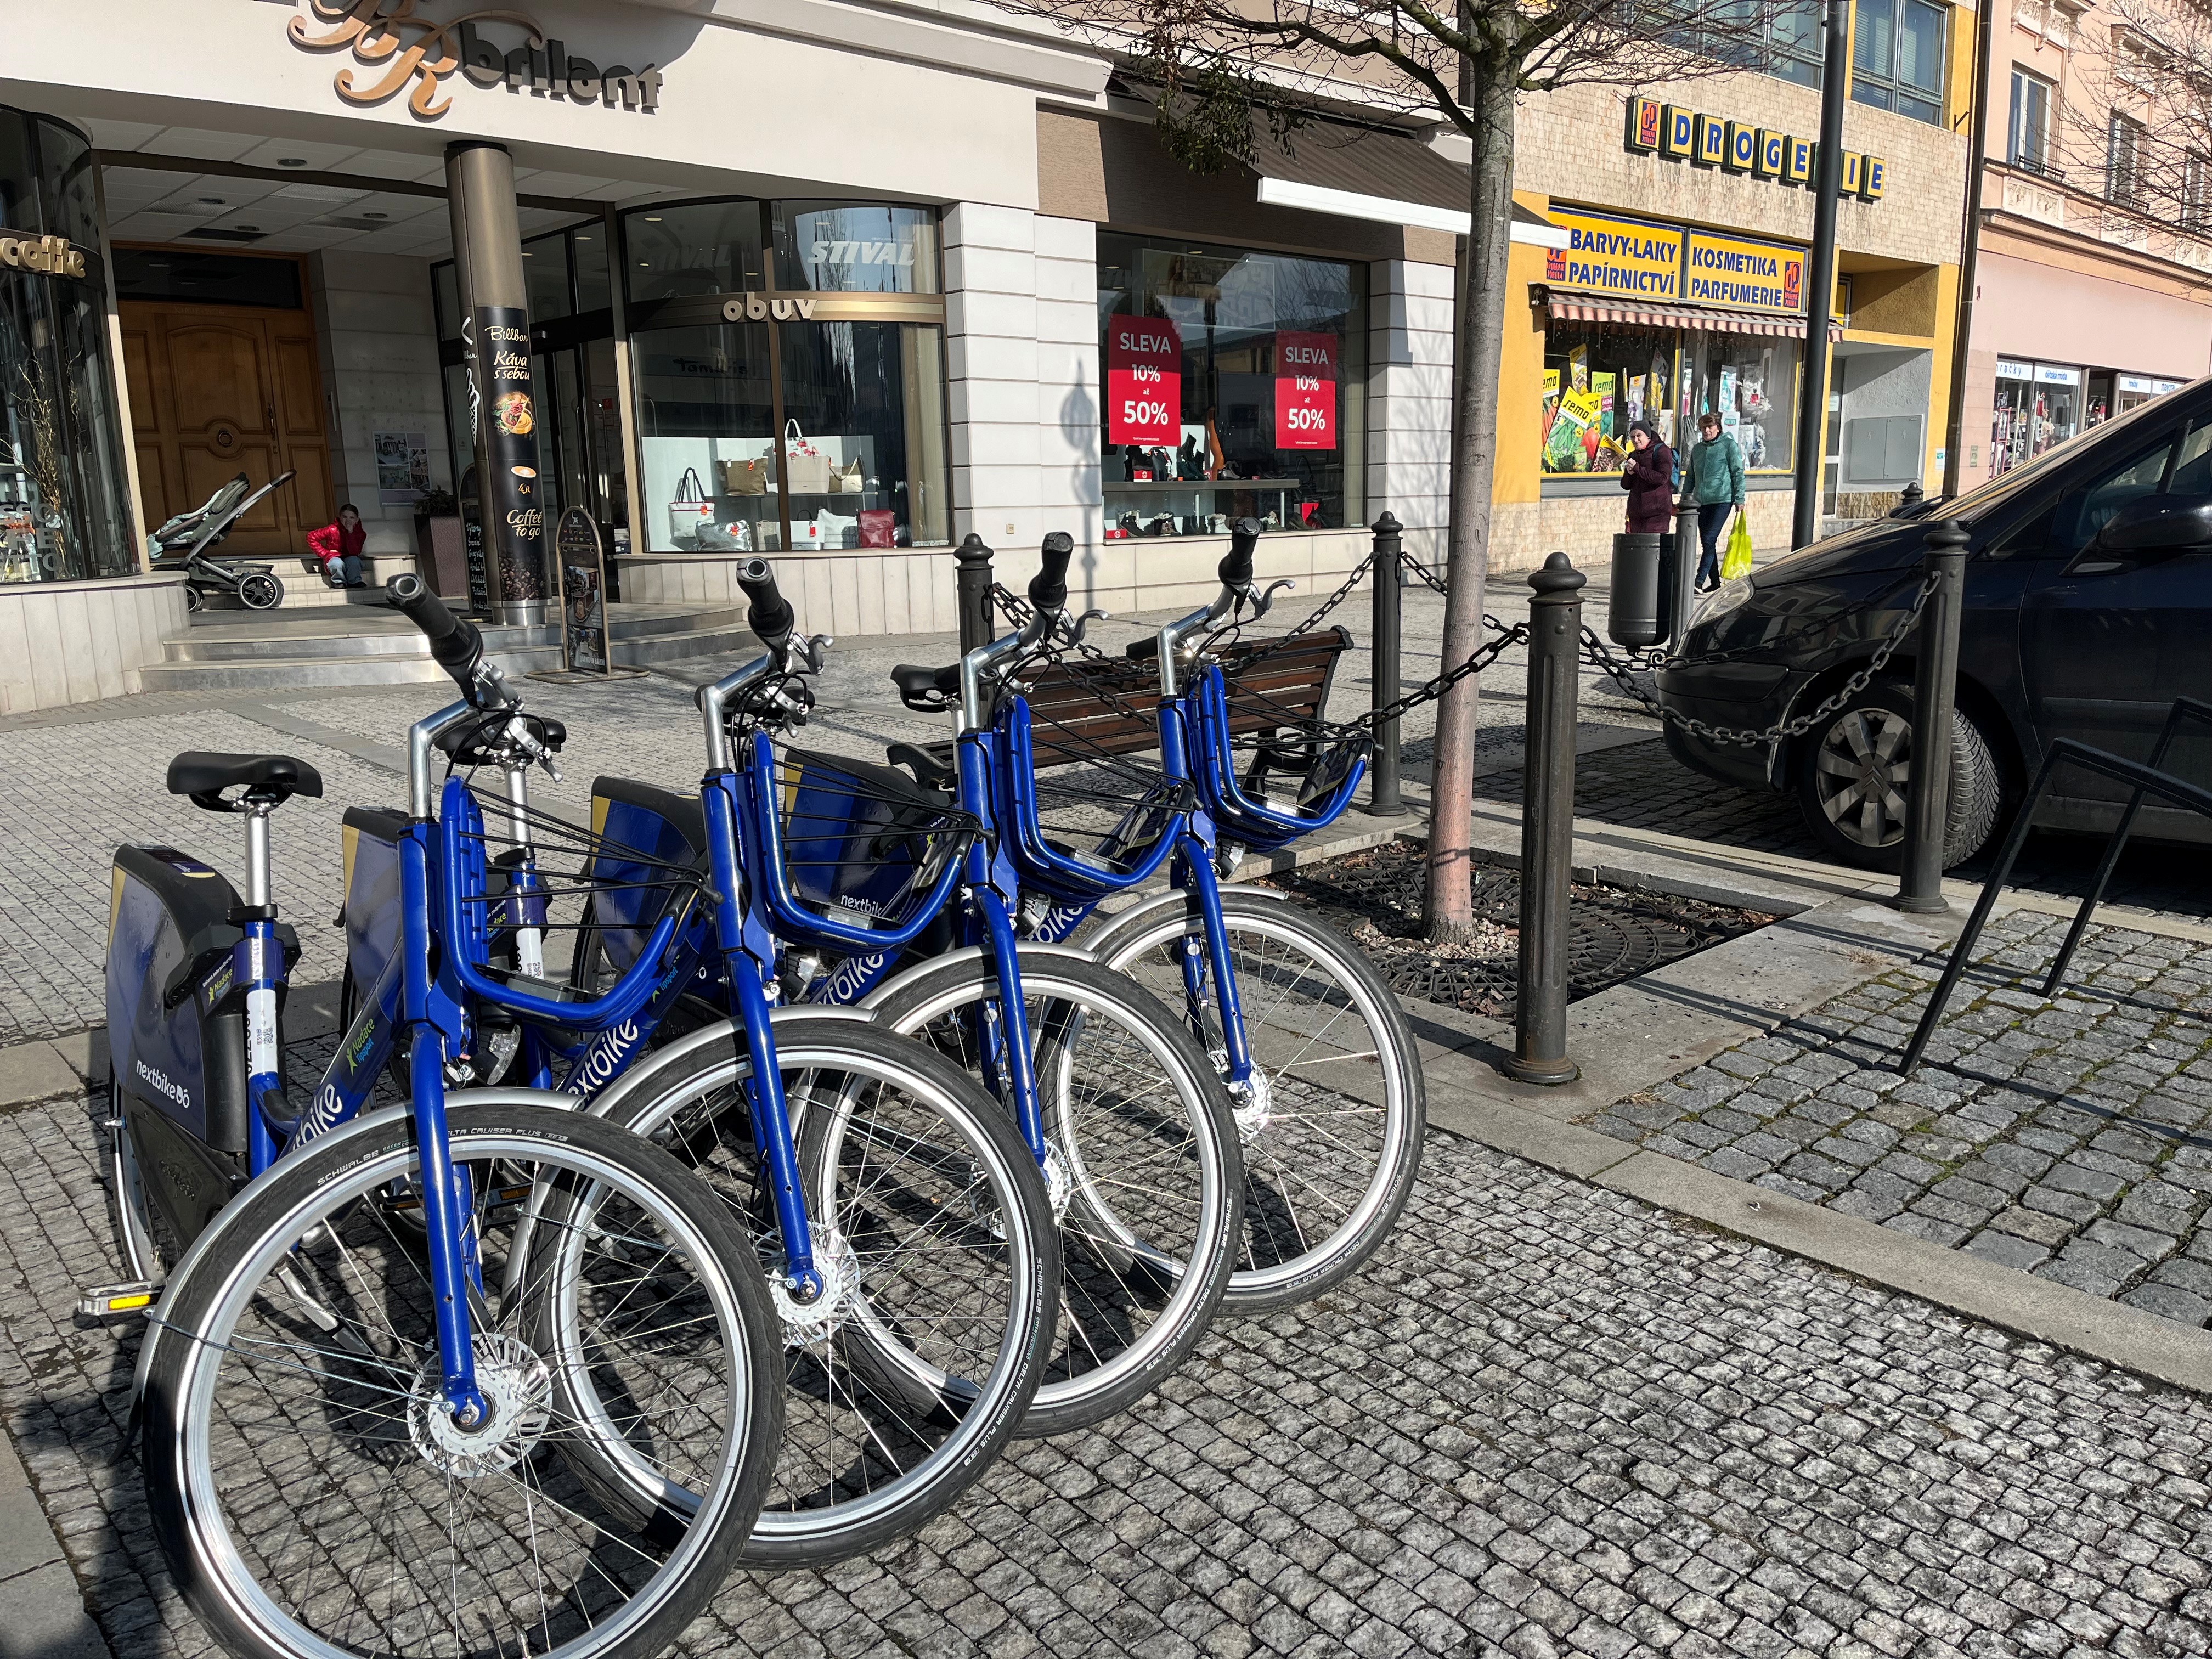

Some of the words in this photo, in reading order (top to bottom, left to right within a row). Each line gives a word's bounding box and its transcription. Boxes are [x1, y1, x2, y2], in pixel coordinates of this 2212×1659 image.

[1674, 114, 1883, 190] DROGEIE
[0, 235, 86, 278] caffe
[807, 241, 915, 266] STIVAL
[1570, 228, 1677, 263] BARVY-LAKY
[1692, 246, 1778, 278] KOSMETIKA
[1568, 262, 1675, 294] PAPÍRNICTVÍ
[1691, 278, 1782, 307] PARFUMERIE
[722, 291, 817, 322] obuv
[484, 326, 528, 342] Billbar
[1120, 332, 1171, 354] SLEVA
[494, 350, 527, 366] Káva
[1286, 346, 1329, 365] SLEVA
[494, 370, 500, 379] s
[501, 366, 530, 380] sebou
[1132, 364, 1160, 382] 10%
[1295, 375, 1319, 391] 10%
[1543, 376, 1557, 389] emo
[1124, 401, 1169, 425] 50%
[1288, 408, 1325, 430] 50%
[1563, 399, 1589, 420] semo
[515, 526, 527, 537] to
[528, 527, 540, 540] go
[840, 894, 882, 916] nextbik
[352, 1018, 375, 1055] Nadace
[356, 1037, 374, 1063] Tipsport
[136, 1059, 176, 1099] nextbike
[317, 1149, 379, 1187] SCHWALBE
[1221, 1198, 1232, 1248] SCHWALBE
[1195, 1288, 1210, 1311] DELTA
[1177, 1310, 1198, 1340] CRUISER
[1161, 1338, 1177, 1358] PLUS
[1014, 1362, 1029, 1391] DELTA
[996, 1390, 1018, 1425] CRUISER
[979, 1425, 996, 1448] PLUS
